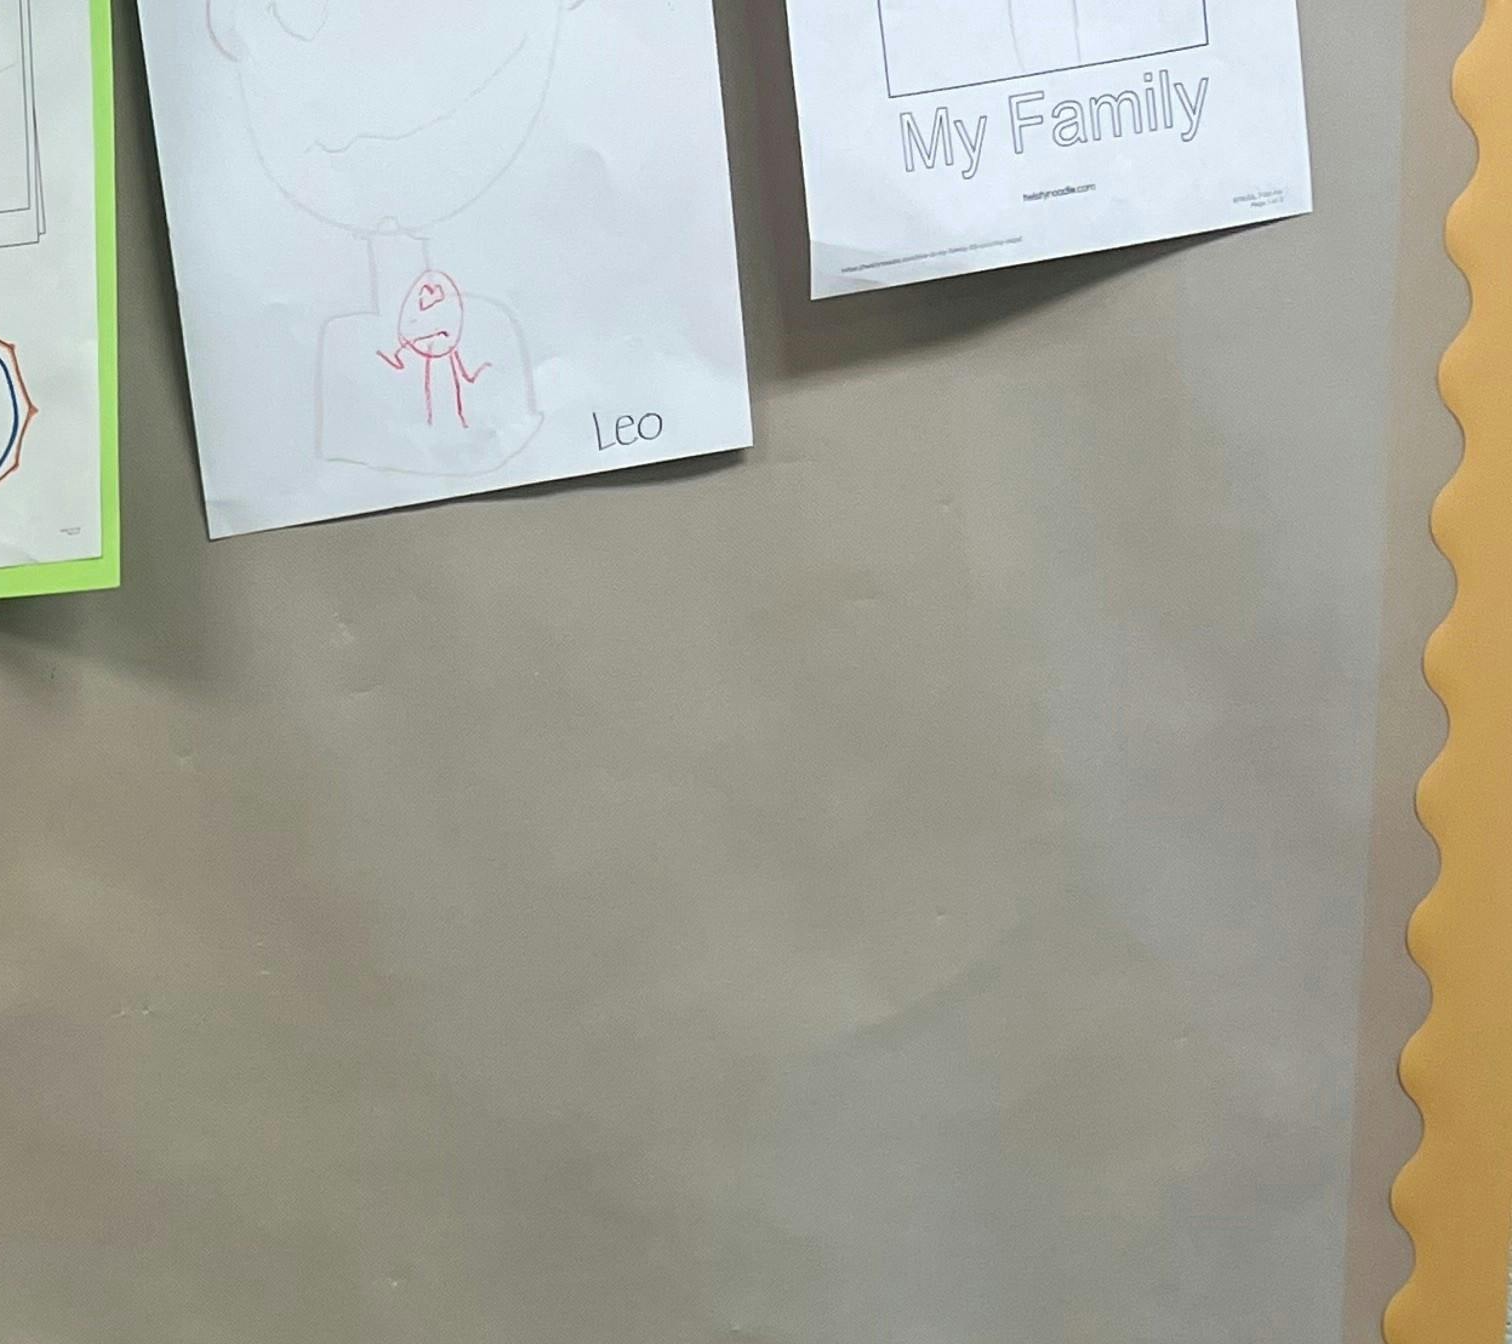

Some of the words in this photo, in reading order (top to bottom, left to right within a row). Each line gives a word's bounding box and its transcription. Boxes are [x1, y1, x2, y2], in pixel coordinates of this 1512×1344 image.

[899, 106, 988, 179] My
[1008, 69, 1209, 155] Family
[592, 412, 663, 451] Leo
